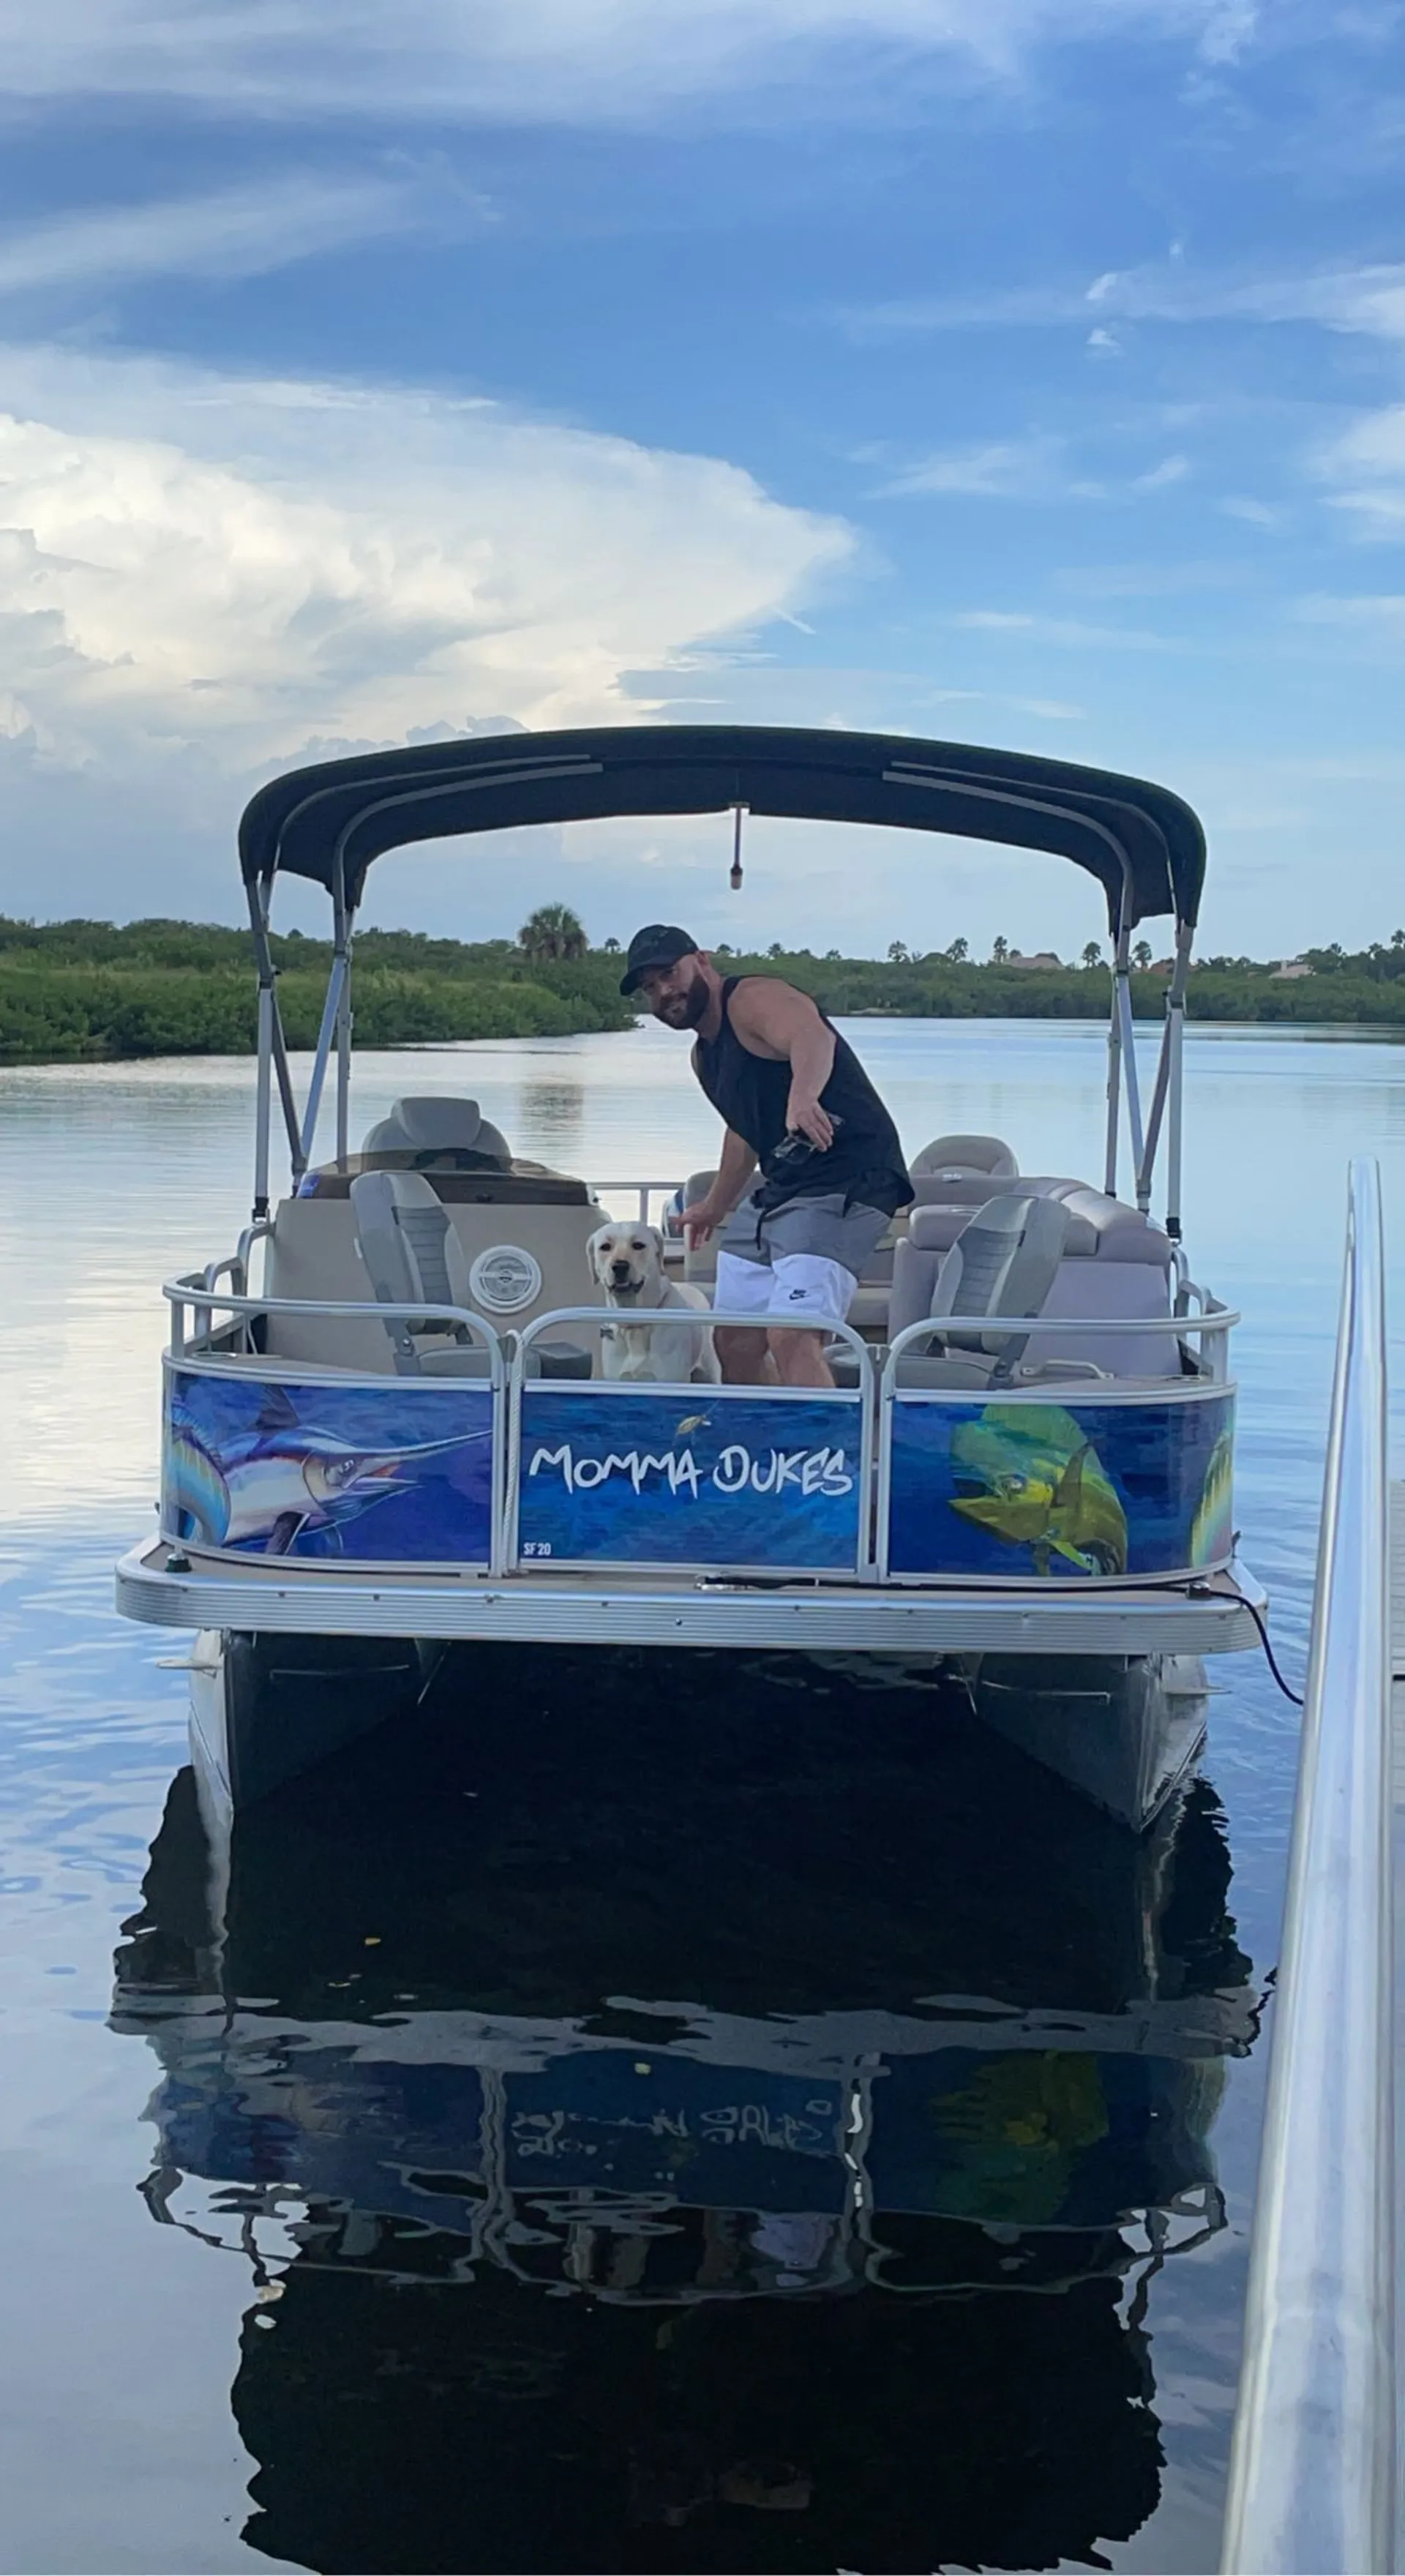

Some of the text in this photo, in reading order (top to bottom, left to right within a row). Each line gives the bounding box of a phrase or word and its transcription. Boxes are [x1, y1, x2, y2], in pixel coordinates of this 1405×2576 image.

[529, 1444, 853, 1499] MOMMA DUKES
[523, 1542, 552, 1556] SF 20
